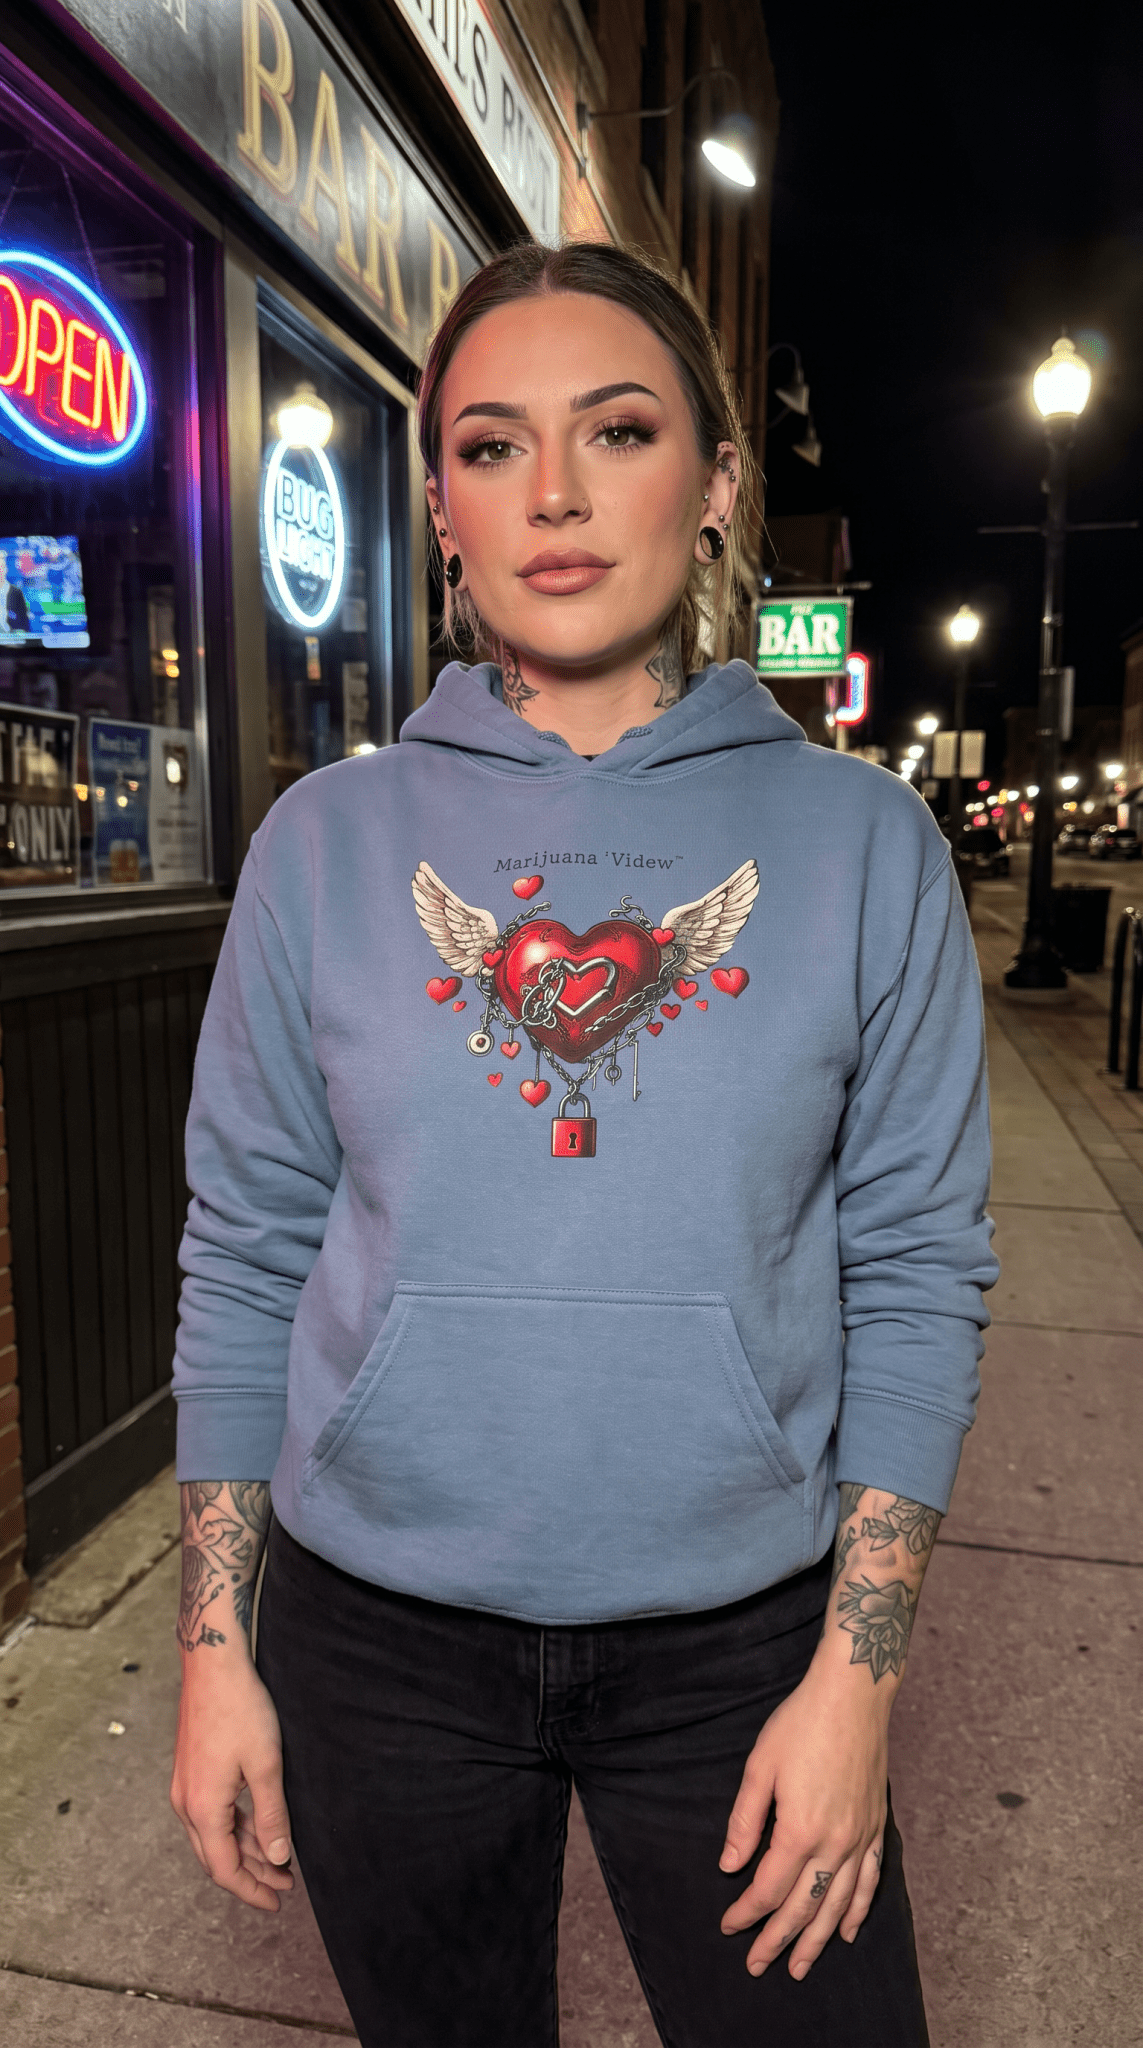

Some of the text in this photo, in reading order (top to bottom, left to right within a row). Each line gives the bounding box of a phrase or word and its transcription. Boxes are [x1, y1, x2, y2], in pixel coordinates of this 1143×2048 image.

[237, 0, 409, 329] BAR
[0, 274, 131, 442] OPEN
[758, 614, 842, 655] BAR
[12, 803, 72, 863] ONLY
[493, 851, 598, 873] Marijuana
